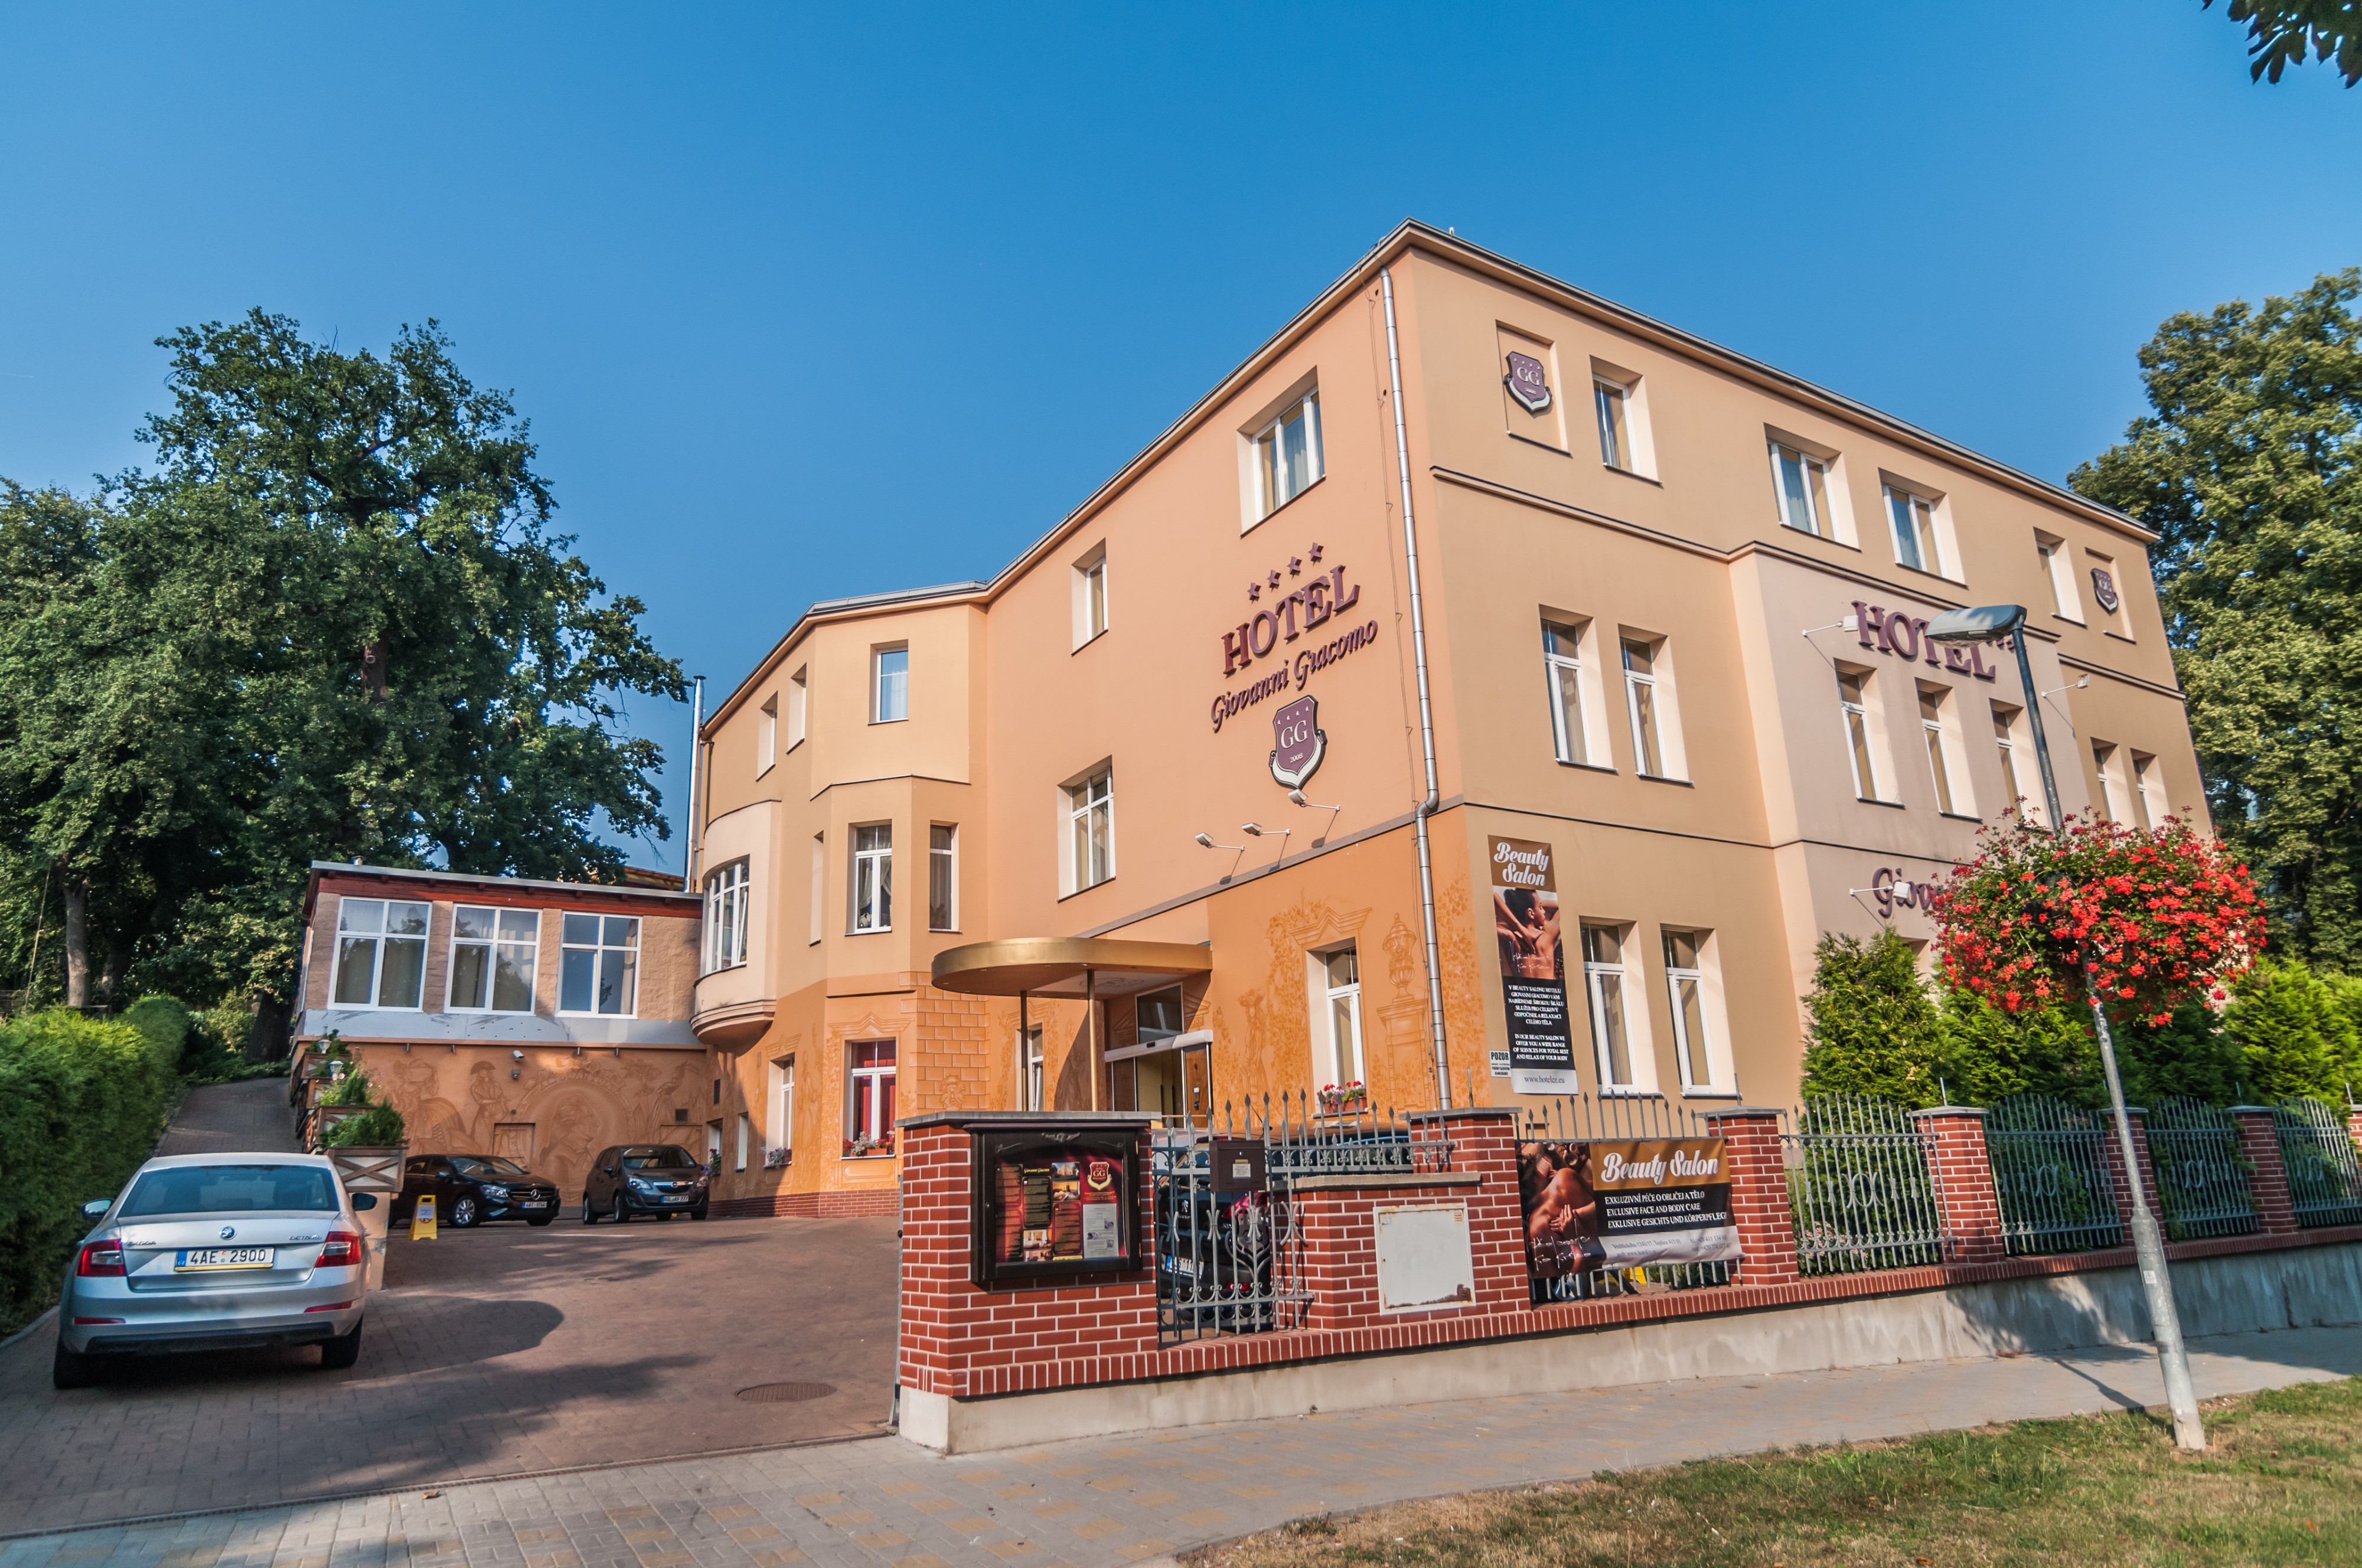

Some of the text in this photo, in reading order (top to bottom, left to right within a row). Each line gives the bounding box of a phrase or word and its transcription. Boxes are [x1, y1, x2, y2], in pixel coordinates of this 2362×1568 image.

[1517, 367, 1539, 386] GG
[1221, 565, 1360, 678] HOTEL
[1211, 620, 1378, 734] Giovanni Giacomo
[1281, 720, 1308, 749] GG
[1494, 842, 1549, 871] Beauty
[1502, 863, 1545, 886] Salon
[1491, 1051, 1509, 1060] POZOR
[1524, 1075, 1565, 1083] www.hotelcz.eu
[1601, 1150, 1718, 1185] Beauty Salon
[1604, 1193, 1642, 1204] EXKLUZIVNÍ
[1662, 1191, 1684, 1201] OBLIČEJ
[1689, 1190, 1705, 1199] TĚLO
[1607, 1207, 1639, 1216] EXCLUSIVE
[1640, 1206, 1655, 1214] FACE
[1655, 1205, 1668, 1213] AND
[1685, 1203, 1701, 1211] CARE
[1608, 1219, 1641, 1228] EXKLUSIVE
[1642, 1217, 1670, 1226] GESICHTS
[1670, 1216, 1684, 1224] UND
[190, 1249, 266, 1265] 4AE 2900
